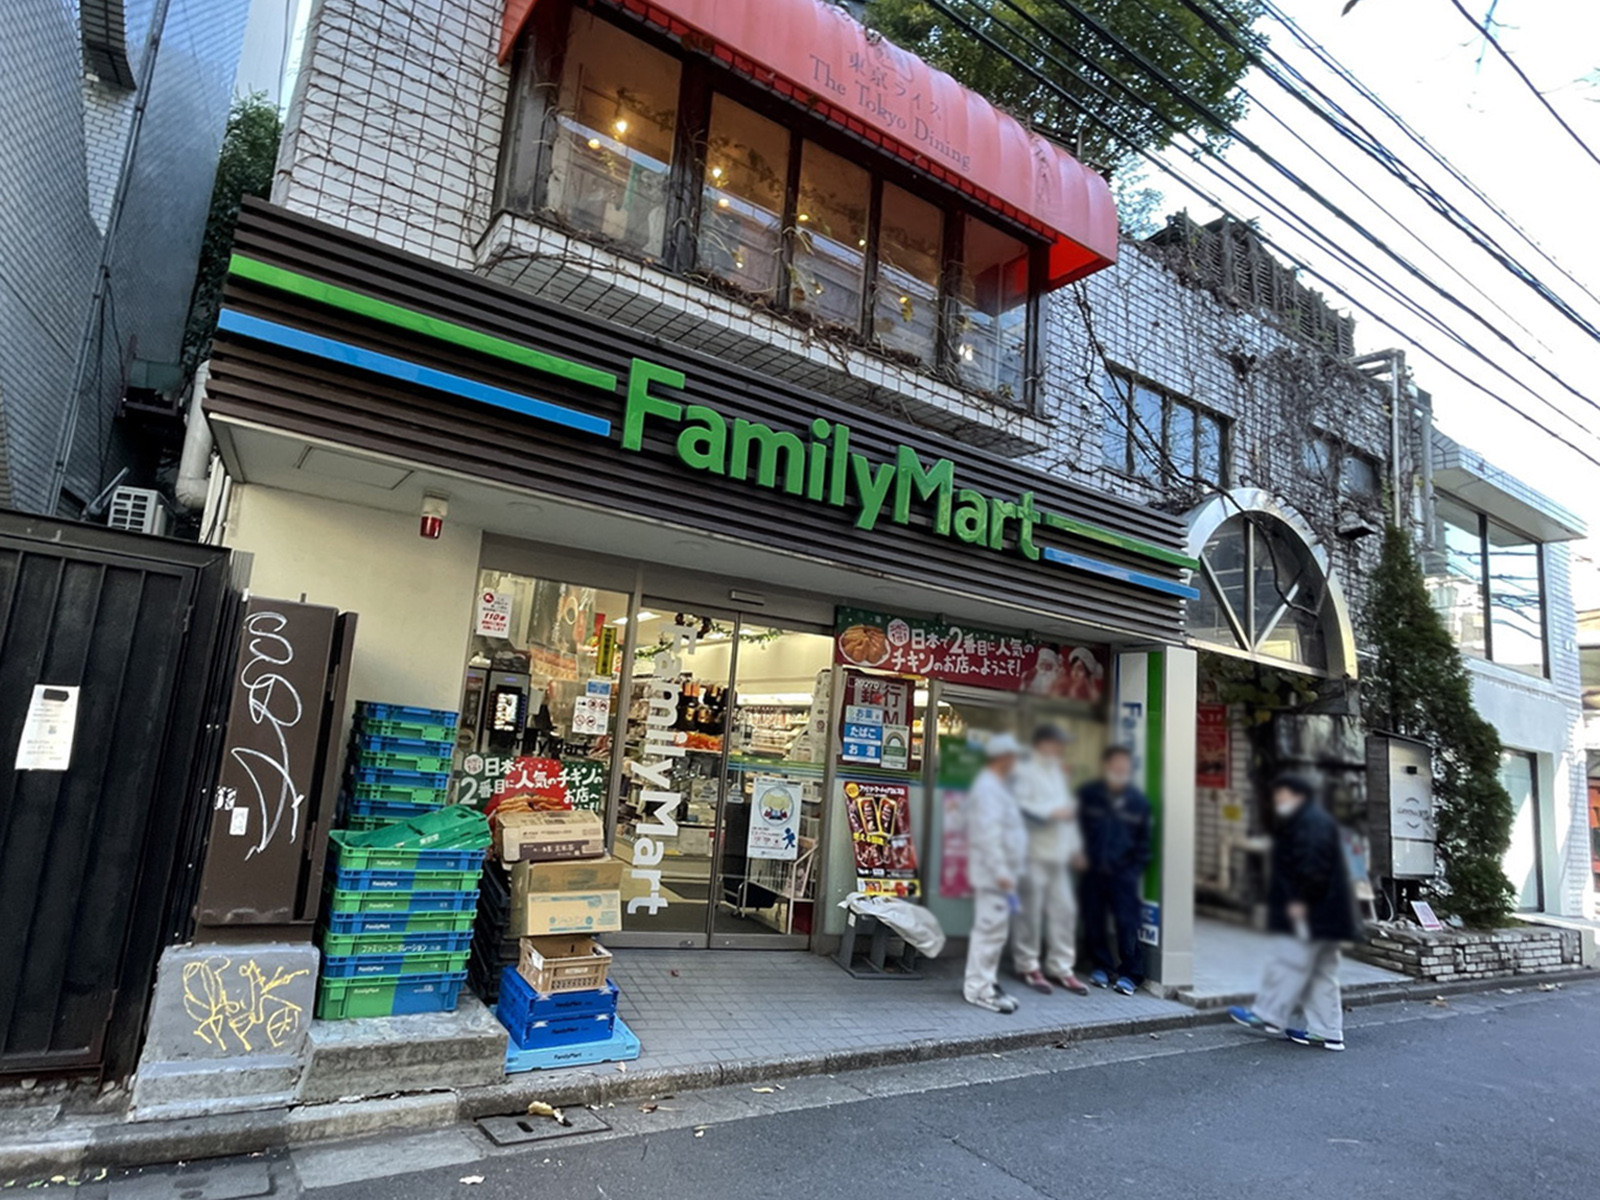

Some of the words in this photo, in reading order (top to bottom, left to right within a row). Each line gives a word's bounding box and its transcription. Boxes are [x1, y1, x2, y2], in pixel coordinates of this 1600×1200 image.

[850, 52, 942, 121] 東京ライス
[809, 55, 847, 96] The
[855, 81, 907, 131] Tokyo
[914, 117, 972, 173] Dining
[620, 357, 1041, 562] FamilyMart
[911, 626, 1035, 660] 日本で2番目に人気の
[849, 726, 876, 739] たばこ
[484, 756, 526, 777] 日本で
[626, 621, 698, 917] FamilyMart
[563, 786, 600, 804] お店へ
